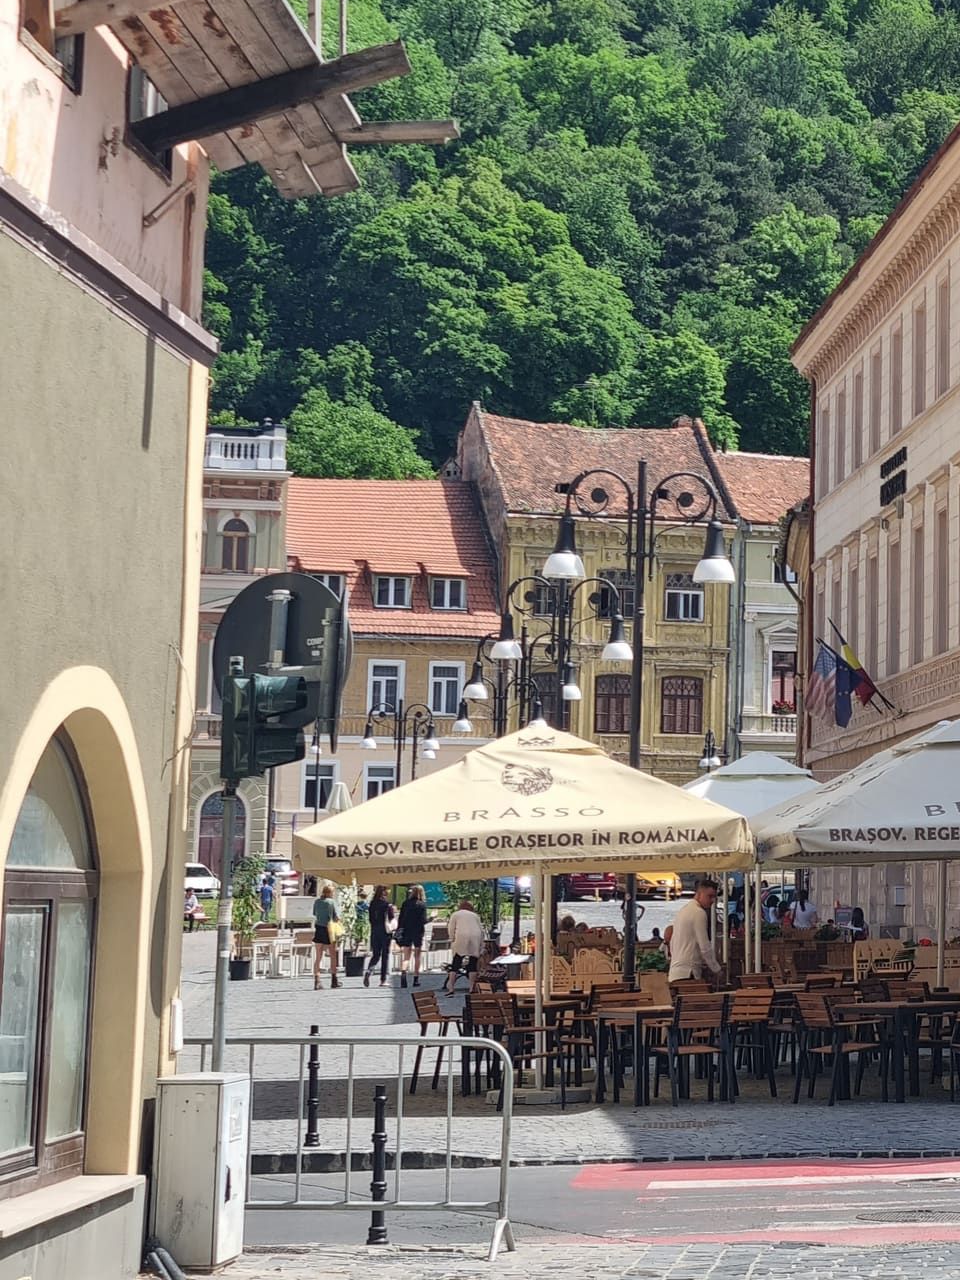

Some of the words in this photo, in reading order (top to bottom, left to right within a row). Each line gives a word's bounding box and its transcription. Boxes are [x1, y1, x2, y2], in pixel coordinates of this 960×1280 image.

[444, 806, 604, 822] BRASSÓ
[326, 841, 404, 859] BRAȘOV.
[412, 838, 478, 854] REGELE
[486, 832, 584, 851] ORAȘELOR
[592, 829, 611, 845] ÎN
[619, 826, 715, 844] ROMÂNIA.
[829, 828, 906, 844] BRAȘOV.
